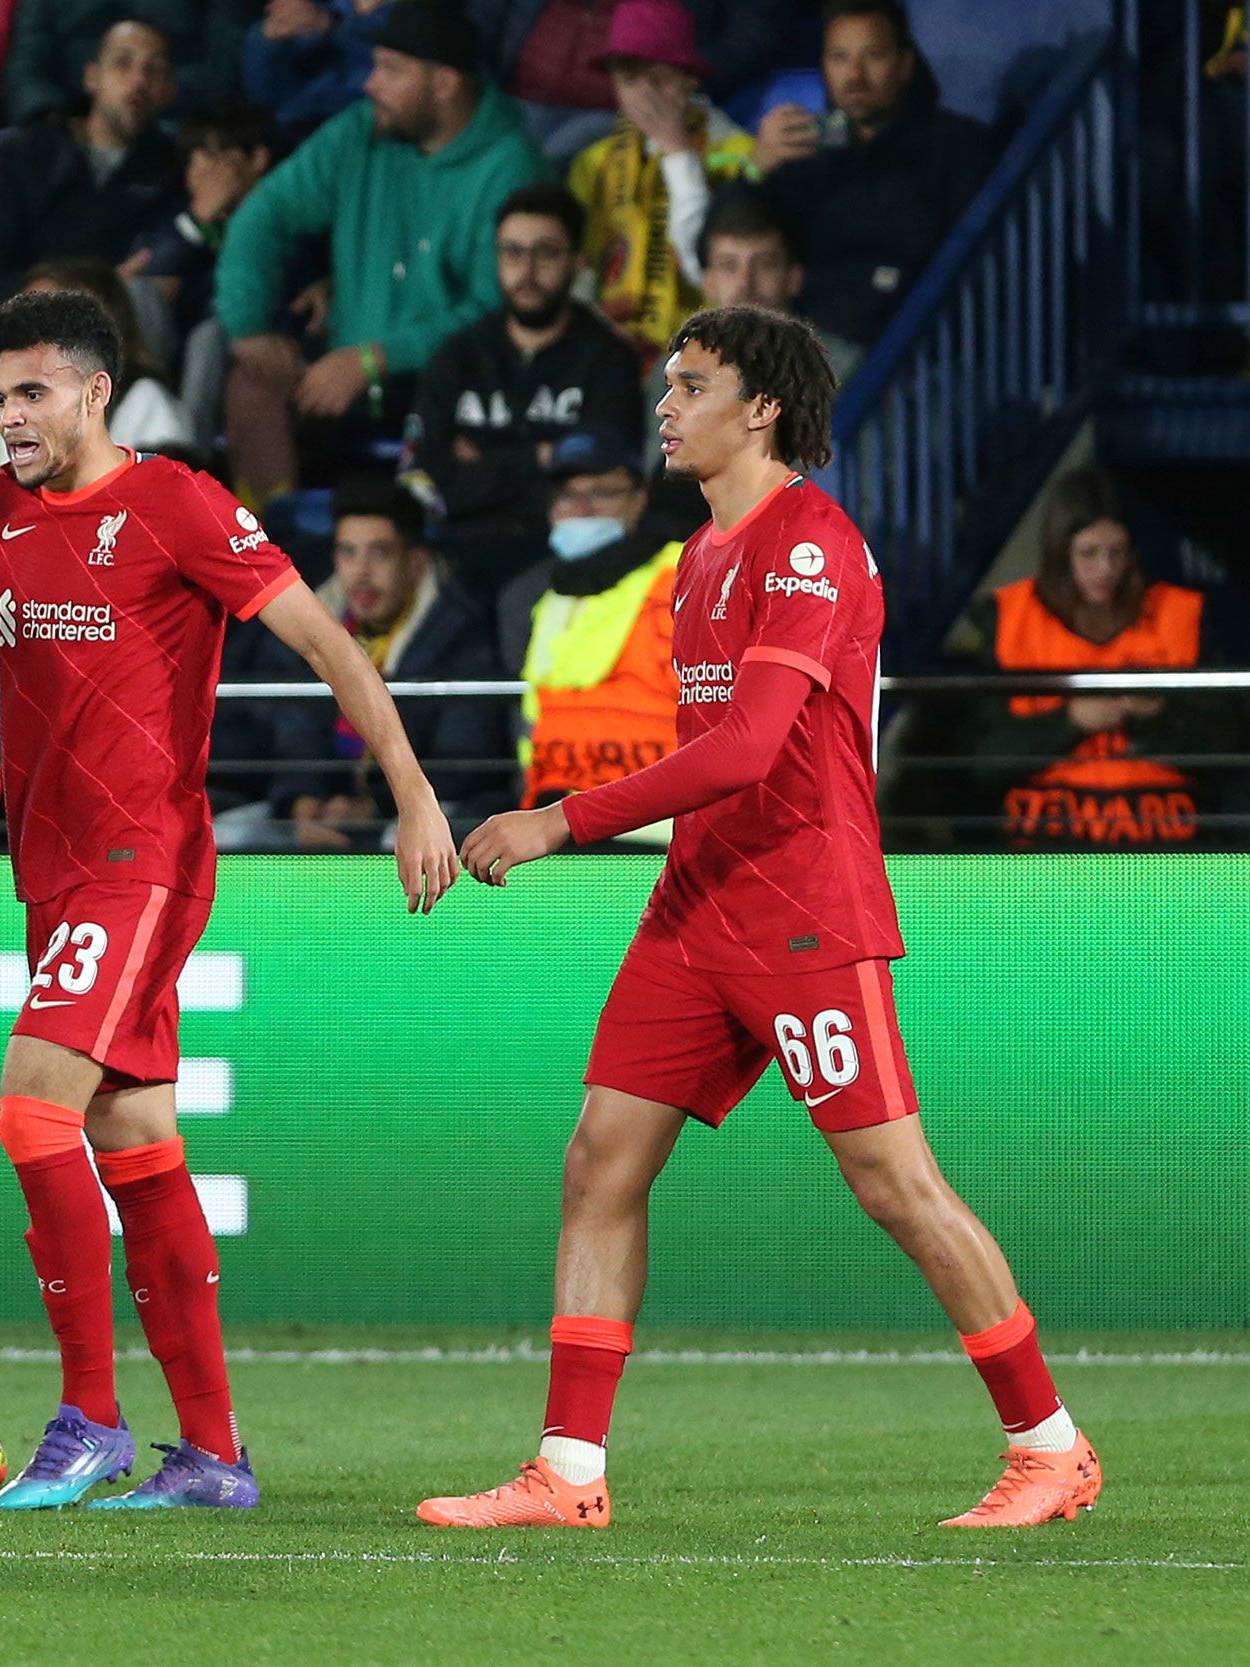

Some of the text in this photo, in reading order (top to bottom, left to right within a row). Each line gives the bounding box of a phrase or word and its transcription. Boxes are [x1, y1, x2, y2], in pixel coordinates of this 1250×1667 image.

[764, 571, 839, 603] Expedia
[22, 600, 111, 623] standard
[22, 620, 116, 641] chartered
[31, 920, 109, 995] 23
[773, 1008, 861, 1088] 66
